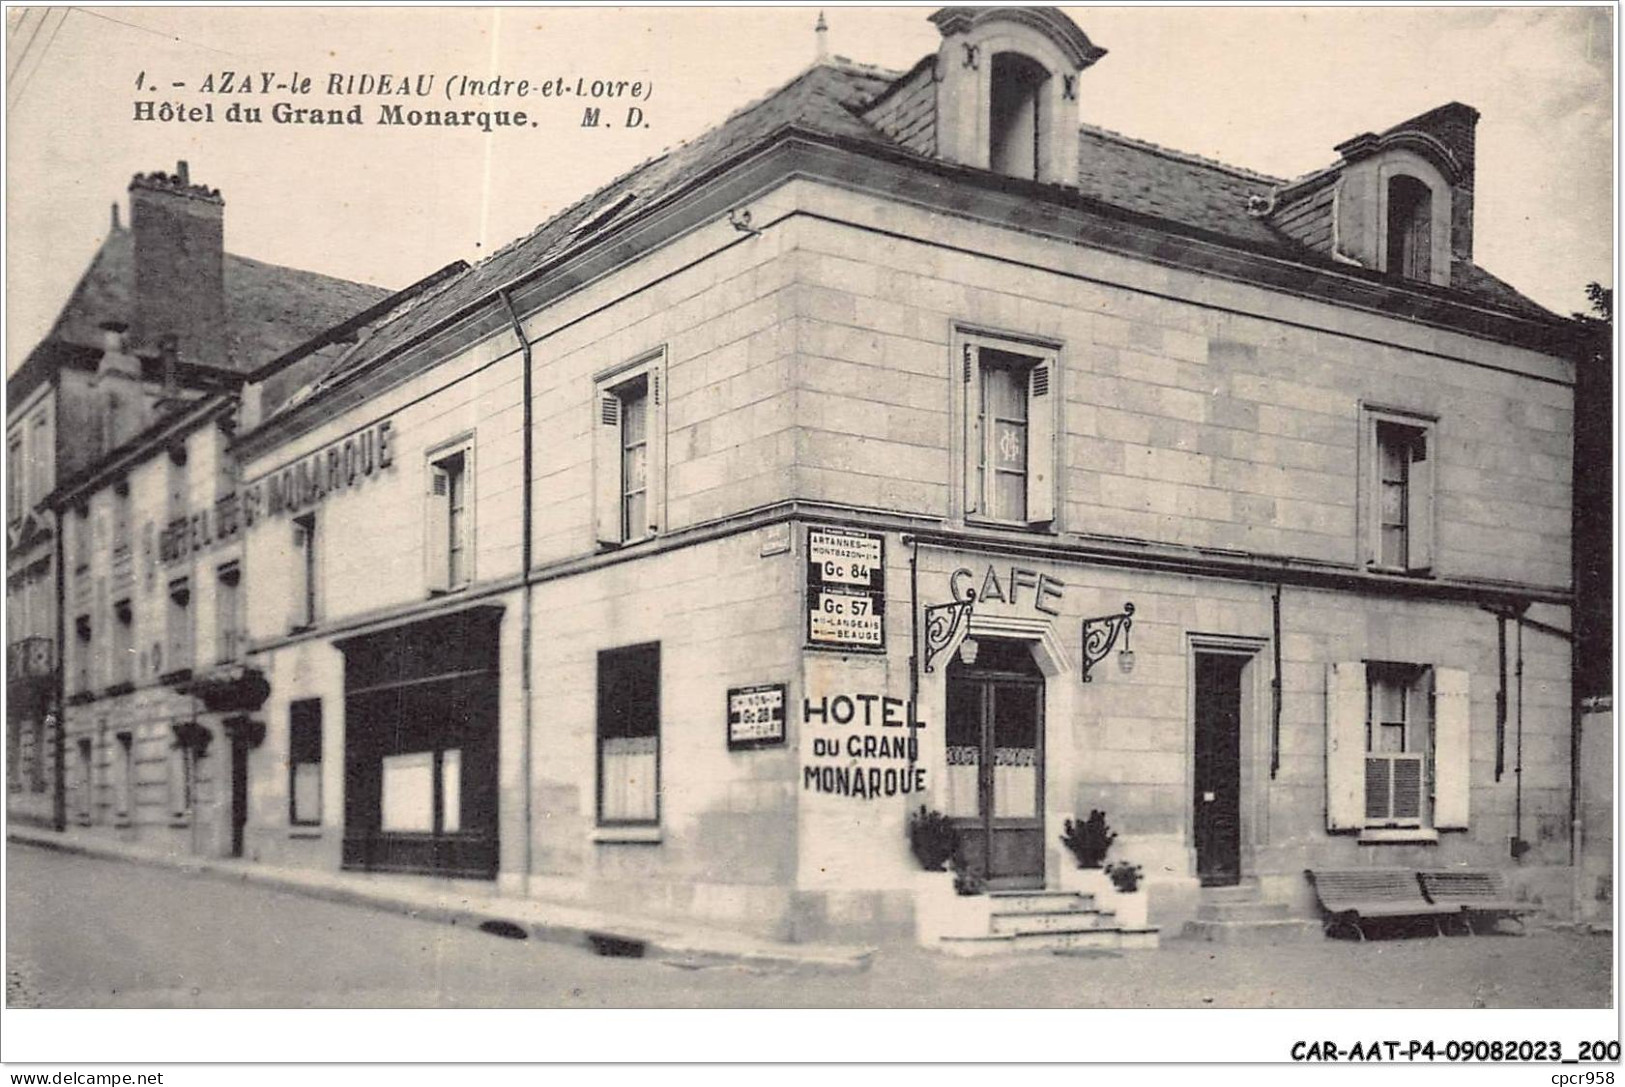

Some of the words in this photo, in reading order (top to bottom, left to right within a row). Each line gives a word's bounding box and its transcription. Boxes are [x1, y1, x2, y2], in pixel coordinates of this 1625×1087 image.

[267, 419, 395, 518] MONARQUE
[825, 561, 844, 577] Gc
[851, 564, 868, 579] 84
[825, 599, 843, 614] Gc
[852, 601, 868, 616] 57
[804, 694, 926, 728] HOTEL
[814, 738, 839, 757] DU
[804, 766, 926, 799] MONARQUE
